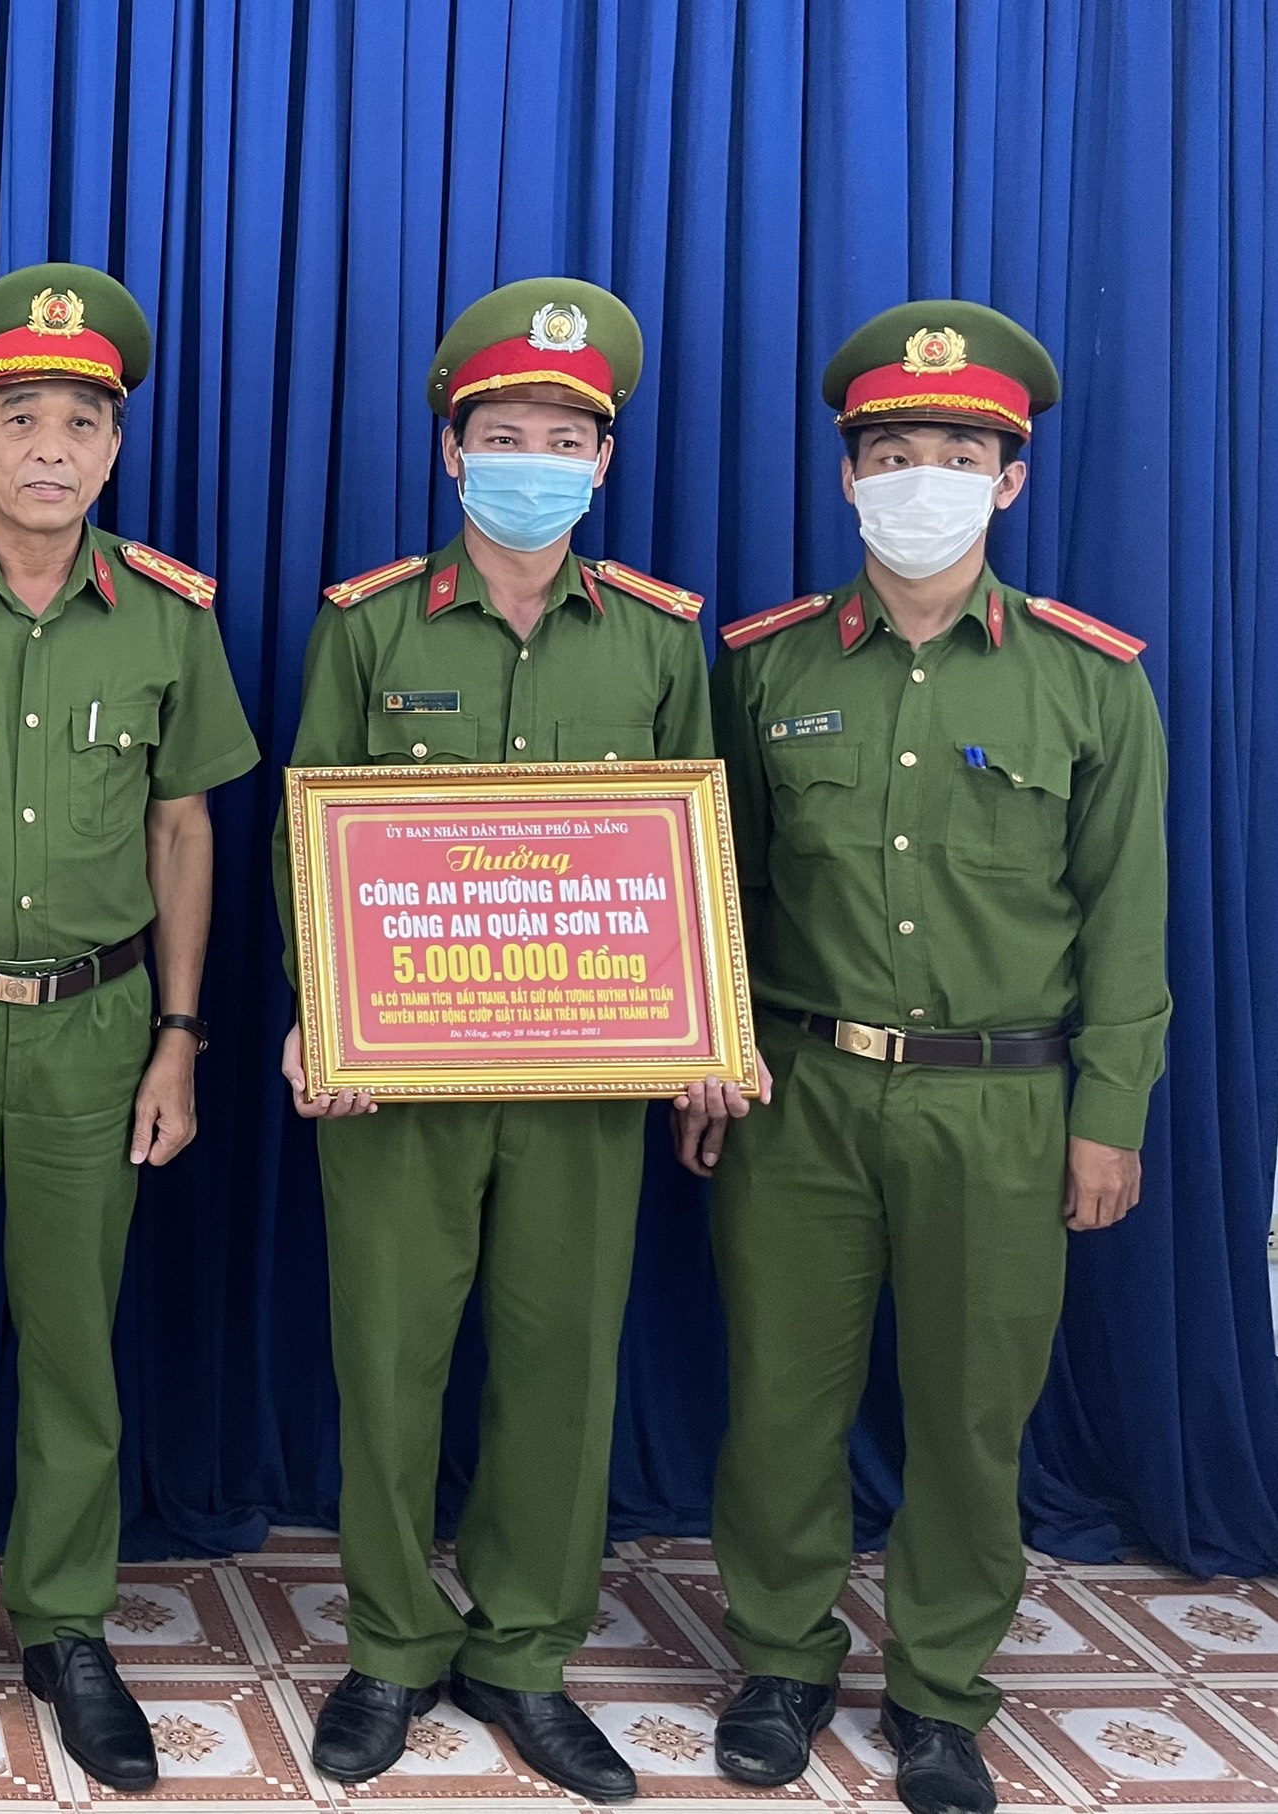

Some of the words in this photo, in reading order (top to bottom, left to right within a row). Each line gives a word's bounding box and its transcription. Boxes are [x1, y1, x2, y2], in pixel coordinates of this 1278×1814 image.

[386, 823, 402, 838] ỦY
[406, 827, 430, 838] BAN
[434, 824, 468, 837] NHÂN
[471, 823, 496, 837] DÂN
[499, 822, 542, 836] THÀNH
[545, 820, 571, 835] PHỐ
[574, 821, 591, 834] ĐÀ
[594, 818, 628, 834] NẴNG
[446, 844, 573, 875] Thưởng
[359, 878, 420, 906] CÔNG
[426, 882, 457, 905] AN
[462, 875, 553, 904] PHƯỜNG
[559, 874, 611, 903] MÂN
[616, 873, 667, 901] THÁI
[383, 911, 444, 939] CÔNG
[450, 914, 481, 938] AN
[487, 908, 548, 941] QUẬN
[554, 909, 601, 936] SƠN
[605, 906, 649, 935] TRÀ
[392, 943, 568, 984] 5.000.000
[577, 945, 647, 983] đồng
[371, 990, 384, 1006] ĐÃ
[386, 990, 398, 1006] CÓ
[400, 989, 430, 1006] THÀNH
[431, 989, 452, 1005] TÍCH
[457, 987, 475, 1005] ĐẤU
[477, 991, 510, 1005] TRANH,
[510, 985, 528, 1004] BẮT
[530, 987, 546, 1004] GIỮ
[547, 985, 563, 1003] ĐỐI
[564, 988, 595, 1005] TƯỢNG
[628, 986, 648, 1002] VĂN
[648, 983, 674, 1001] TUẤN
[379, 1008, 415, 1024] CHUYÊN
[416, 1010, 439, 1026] HOẠT
[441, 1007, 467, 1026] ĐỘNG
[495, 1006, 515, 1025] GIẬT
[517, 1005, 532, 1022] TÀI
[533, 1004, 553, 1022] SẢN
[554, 1005, 579, 1021] TRÊN
[579, 1007, 596, 1024] ĐỊA
[597, 1004, 617, 1020] BÀN
[649, 1002, 669, 1020] PHỐ
